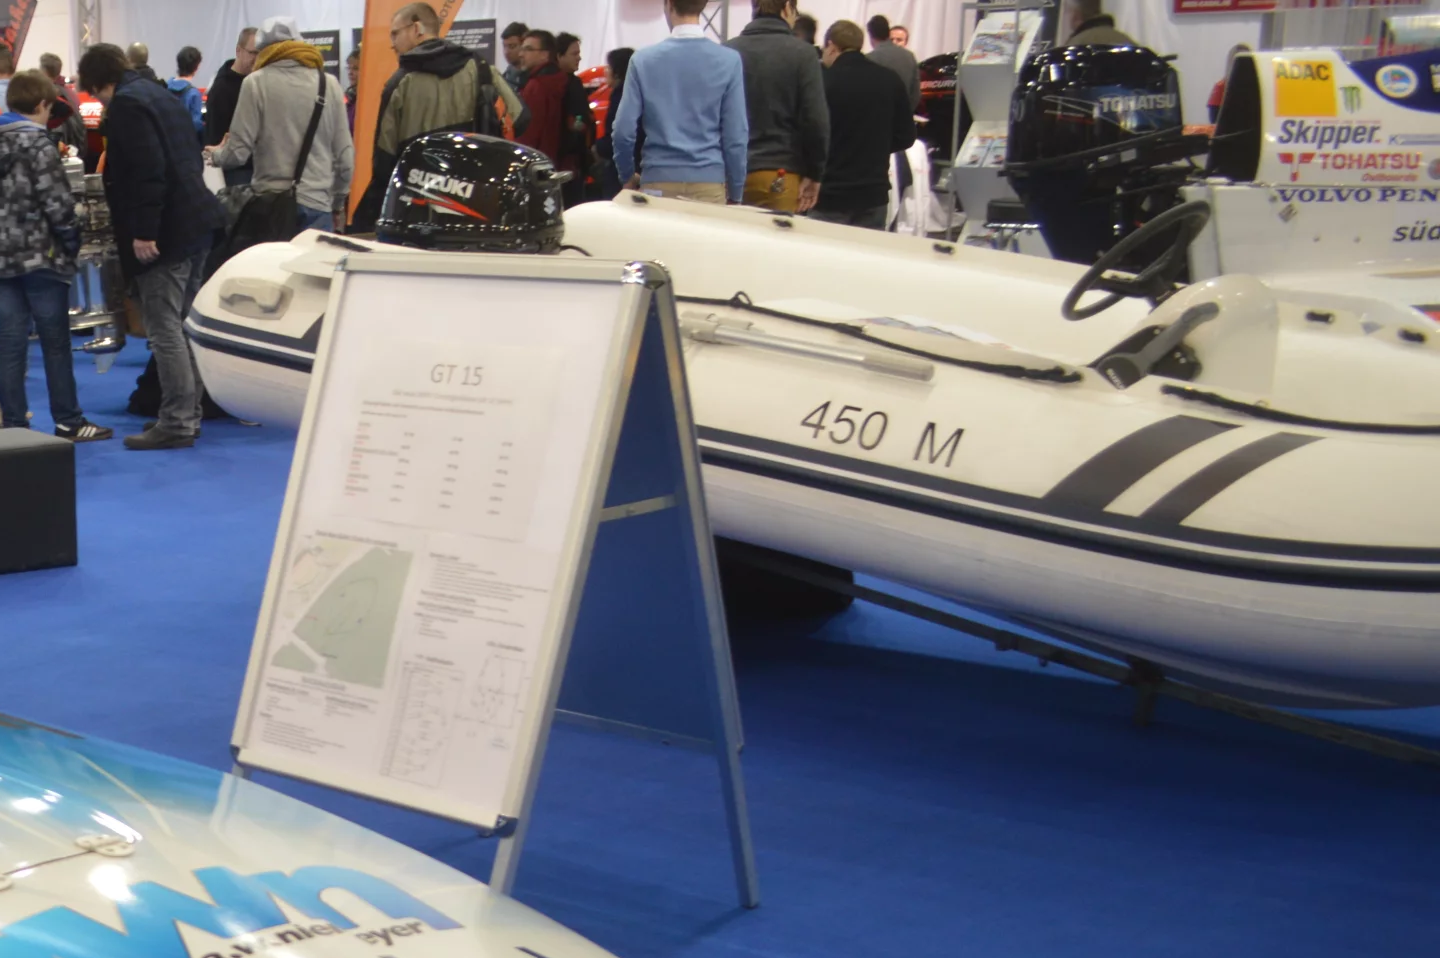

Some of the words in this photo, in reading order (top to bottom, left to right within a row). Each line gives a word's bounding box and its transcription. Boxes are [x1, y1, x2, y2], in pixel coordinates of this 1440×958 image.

[1276, 64, 1329, 81] ADAC
[920, 80, 957, 89] ERCURY
[1100, 93, 1177, 112] TOHATSU
[1320, 152, 1421, 170] TOHATSU
[408, 168, 475, 199] SUZUKI
[1276, 188, 1372, 203] VOLVO
[430, 363, 458, 384] GT
[460, 365, 484, 386] 15
[800, 399, 889, 451] 450
[912, 421, 966, 468] M
